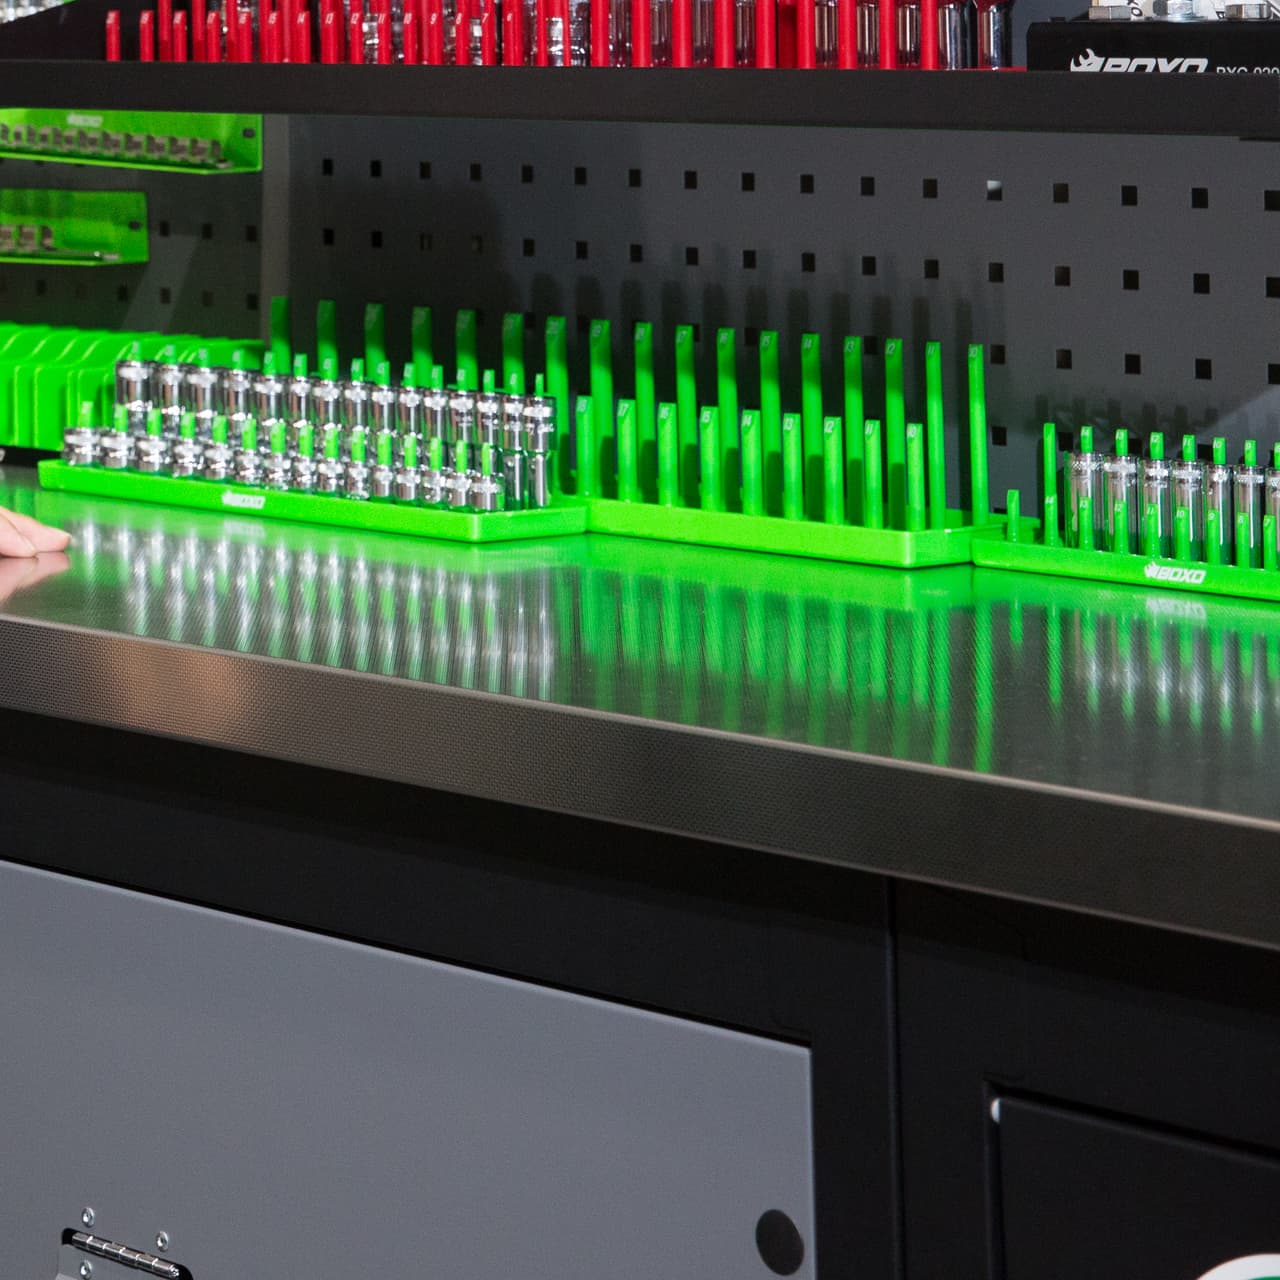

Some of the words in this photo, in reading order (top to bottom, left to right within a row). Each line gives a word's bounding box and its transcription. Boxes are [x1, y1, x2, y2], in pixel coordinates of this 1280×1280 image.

[269, 13, 277, 24] 15
[297, 13, 305, 24] 14
[325, 13, 334, 24] 13
[351, 13, 359, 24] 12
[377, 13, 385, 24] 11
[403, 13, 412, 24] 10
[430, 13, 437, 25] 9
[456, 12, 462, 25] 8
[482, 13, 488, 23] 7
[844, 340, 855, 352] 13
[885, 343, 896, 355] 12
[968, 347, 978, 358] 10
[824, 420, 834, 433] 12
[865, 423, 874, 435] 11
[1183, 438, 1191, 446] 11
[1213, 440, 1222, 448] 10
[1146, 507, 1155, 515] 11
[1176, 509, 1185, 517] 10
[1157, 564, 1207, 584] BOXO
